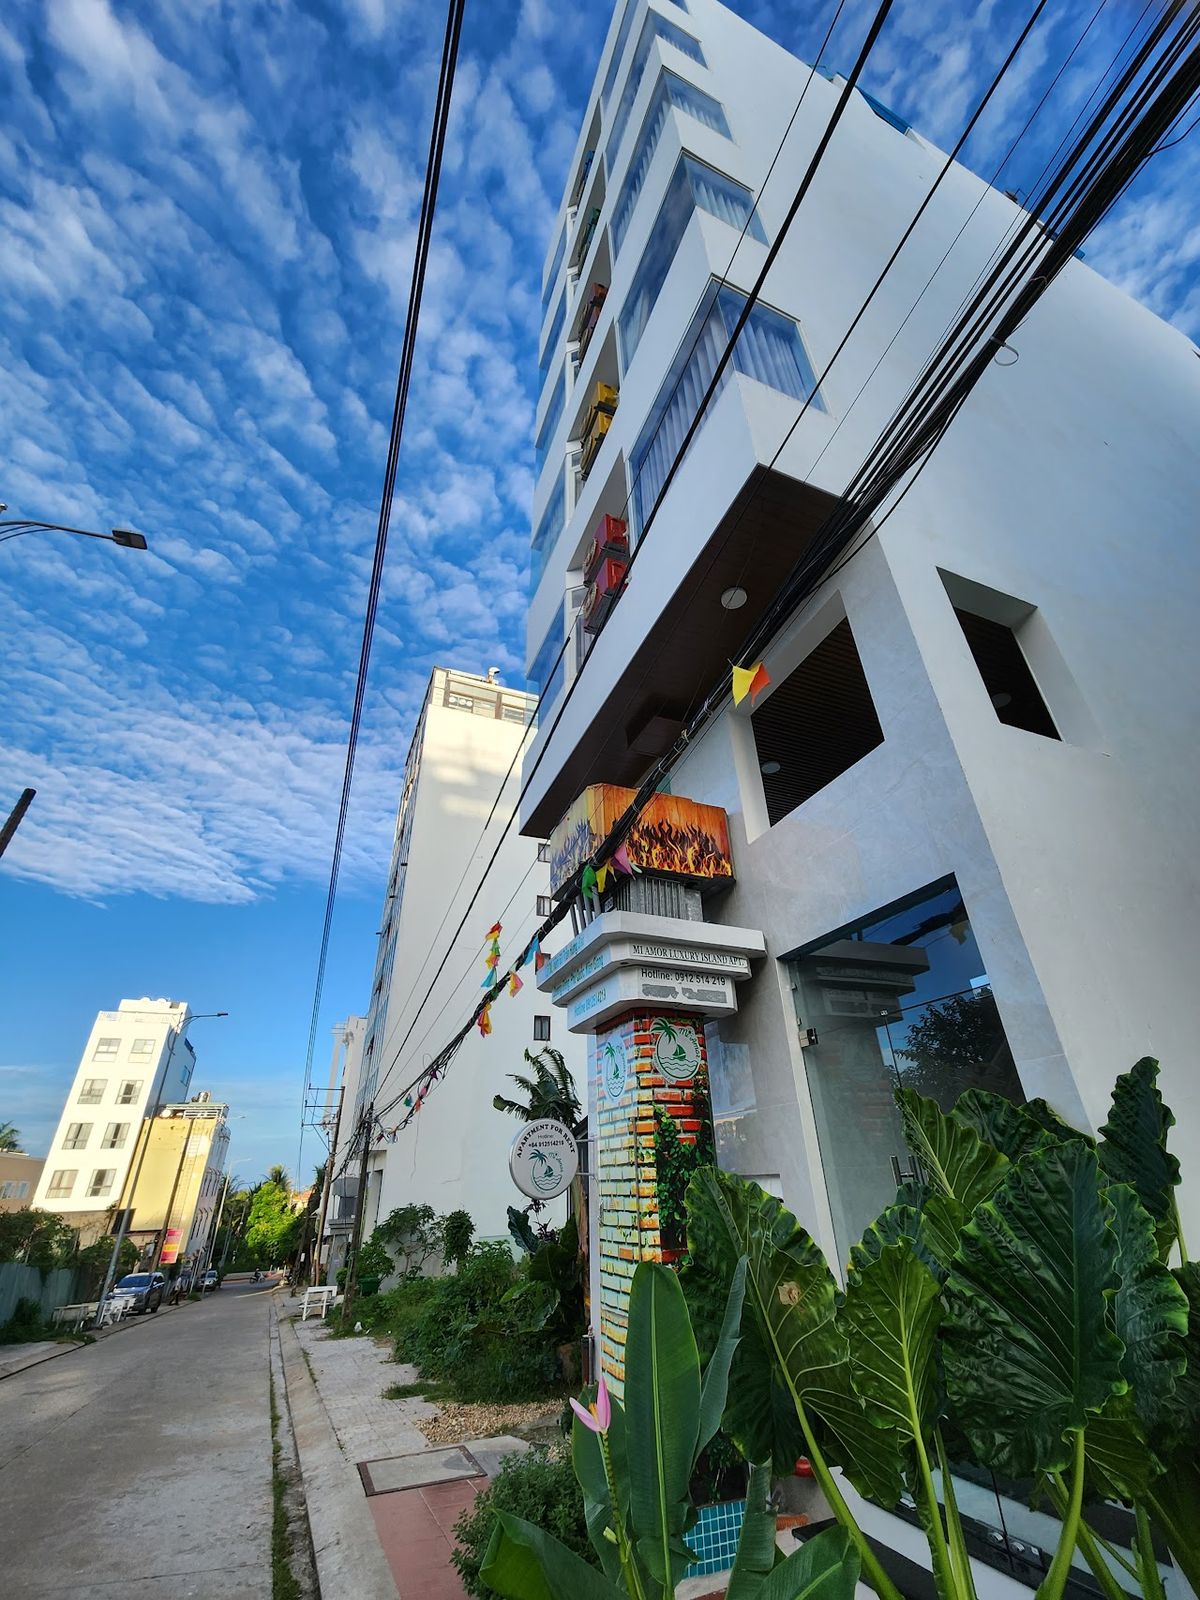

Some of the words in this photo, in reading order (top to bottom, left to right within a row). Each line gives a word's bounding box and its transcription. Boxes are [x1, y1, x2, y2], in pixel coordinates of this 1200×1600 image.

[632, 944, 643, 955] MI
[645, 946, 668, 957] AMOR
[668, 949, 699, 961] LUXURY
[701, 953, 727, 964] ISLAND
[641, 968, 673, 981] Hotline:
[675, 972, 694, 983] 0912
[695, 975, 710, 985] 514
[712, 976, 726, 986] 219
[517, 1124, 549, 1158] APARTMENT
[550, 1125, 563, 1135] FOR
[563, 1133, 575, 1153] RENT
